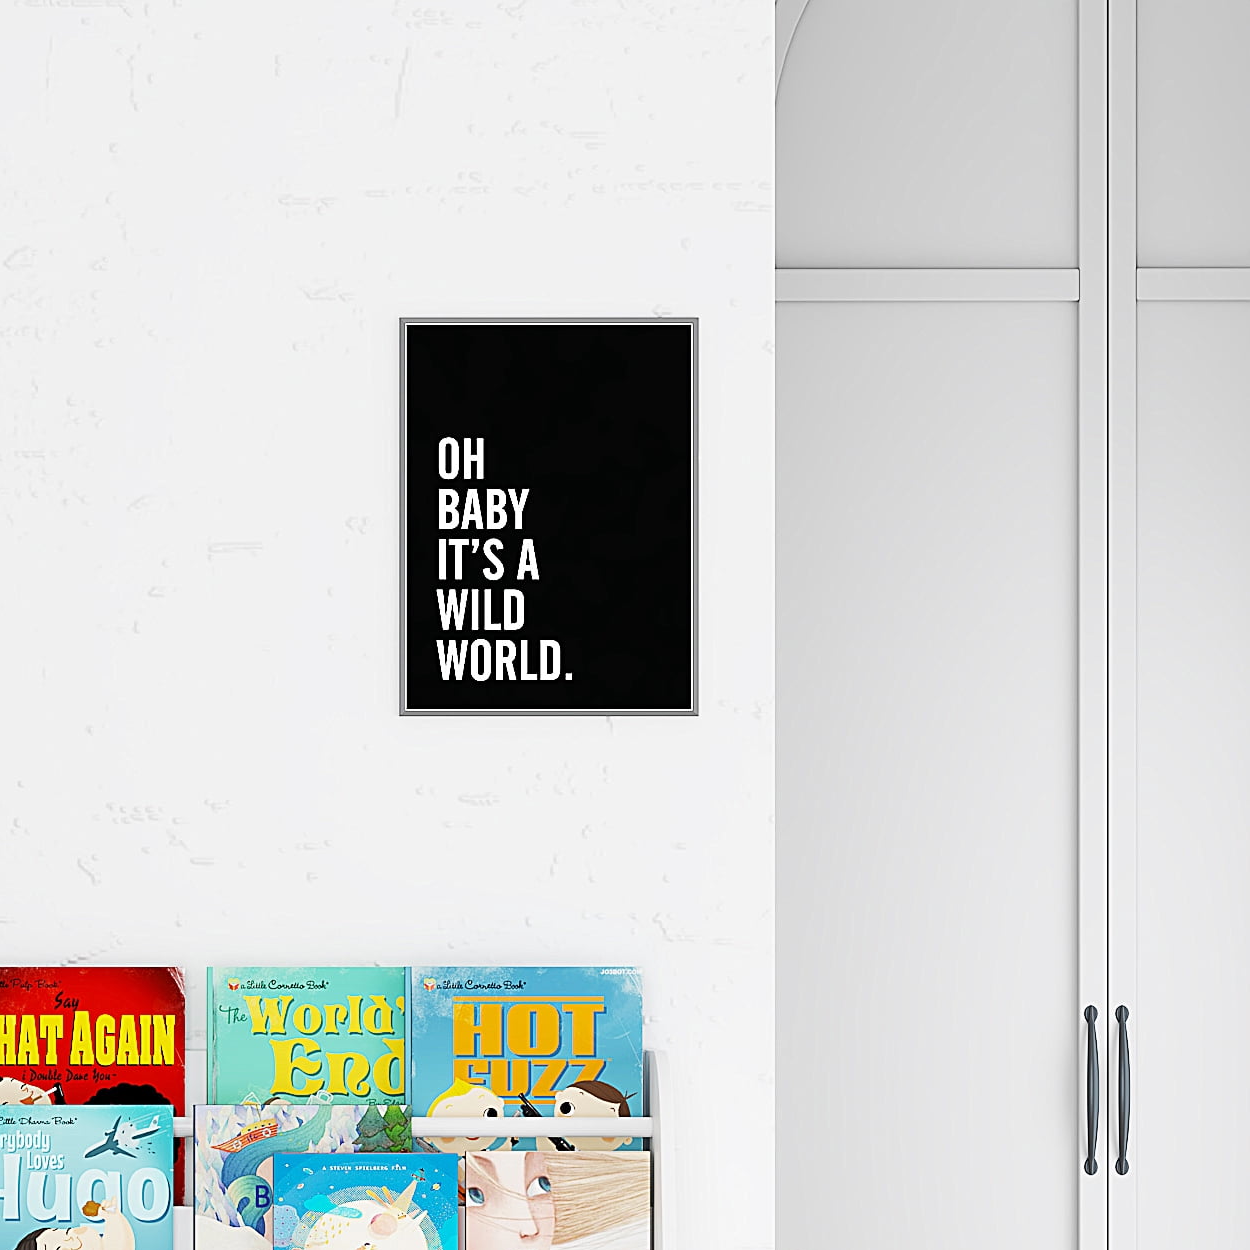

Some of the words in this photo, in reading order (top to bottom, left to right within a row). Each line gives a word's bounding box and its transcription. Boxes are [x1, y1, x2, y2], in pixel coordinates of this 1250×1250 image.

[438, 436, 485, 480] OH
[438, 488, 530, 530] BABY
[438, 538, 505, 581] IT'S
[516, 538, 540, 581] A
[436, 588, 525, 631] WILD
[436, 638, 573, 682] WORLD.
[11, 979, 33, 991] Pulp
[246, 980, 267, 990] Little
[268, 979, 305, 990] Cornetto
[306, 980, 327, 990] Book
[442, 980, 463, 990] Little
[464, 979, 502, 990] Cornetto
[502, 980, 524, 990] Book
[54, 991, 80, 1011] Say
[218, 1005, 248, 1025] The
[69, 1010, 176, 1066] AGAIN
[453, 1003, 606, 1058] HOT
[29, 1069, 62, 1082] Double
[65, 1069, 89, 1081] Dare
[453, 1059, 606, 1098] FUZZ
[18, 1117, 50, 1125] Dharma
[52, 1116, 75, 1125] Book
[26, 1151, 65, 1170] Loves
